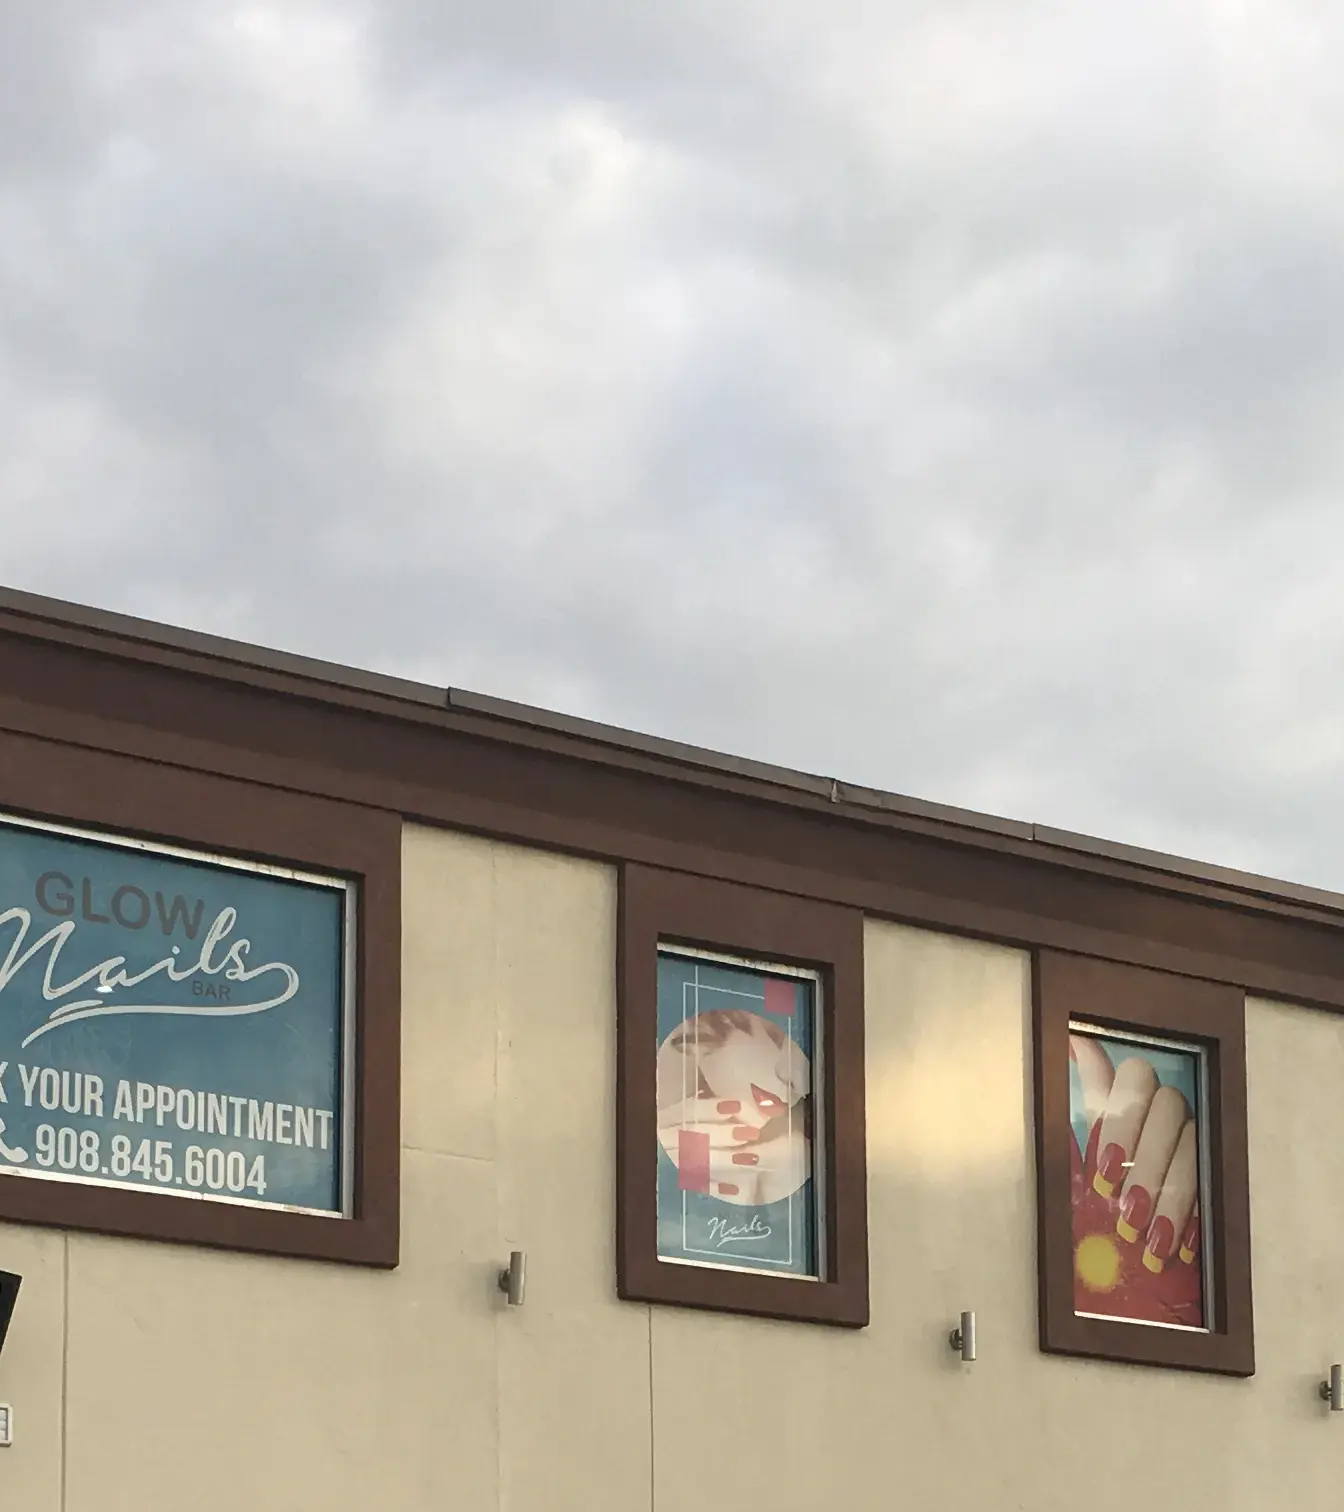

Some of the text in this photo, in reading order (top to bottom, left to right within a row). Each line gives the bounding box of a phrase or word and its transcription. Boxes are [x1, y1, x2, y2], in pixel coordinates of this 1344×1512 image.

[35, 871, 205, 939] GLOW
[192, 980, 231, 1000] BAR
[18, 1064, 104, 1118] YOUR
[113, 1079, 334, 1150] APPOINTMENT
[35, 1124, 267, 1195] 908.845.6004
